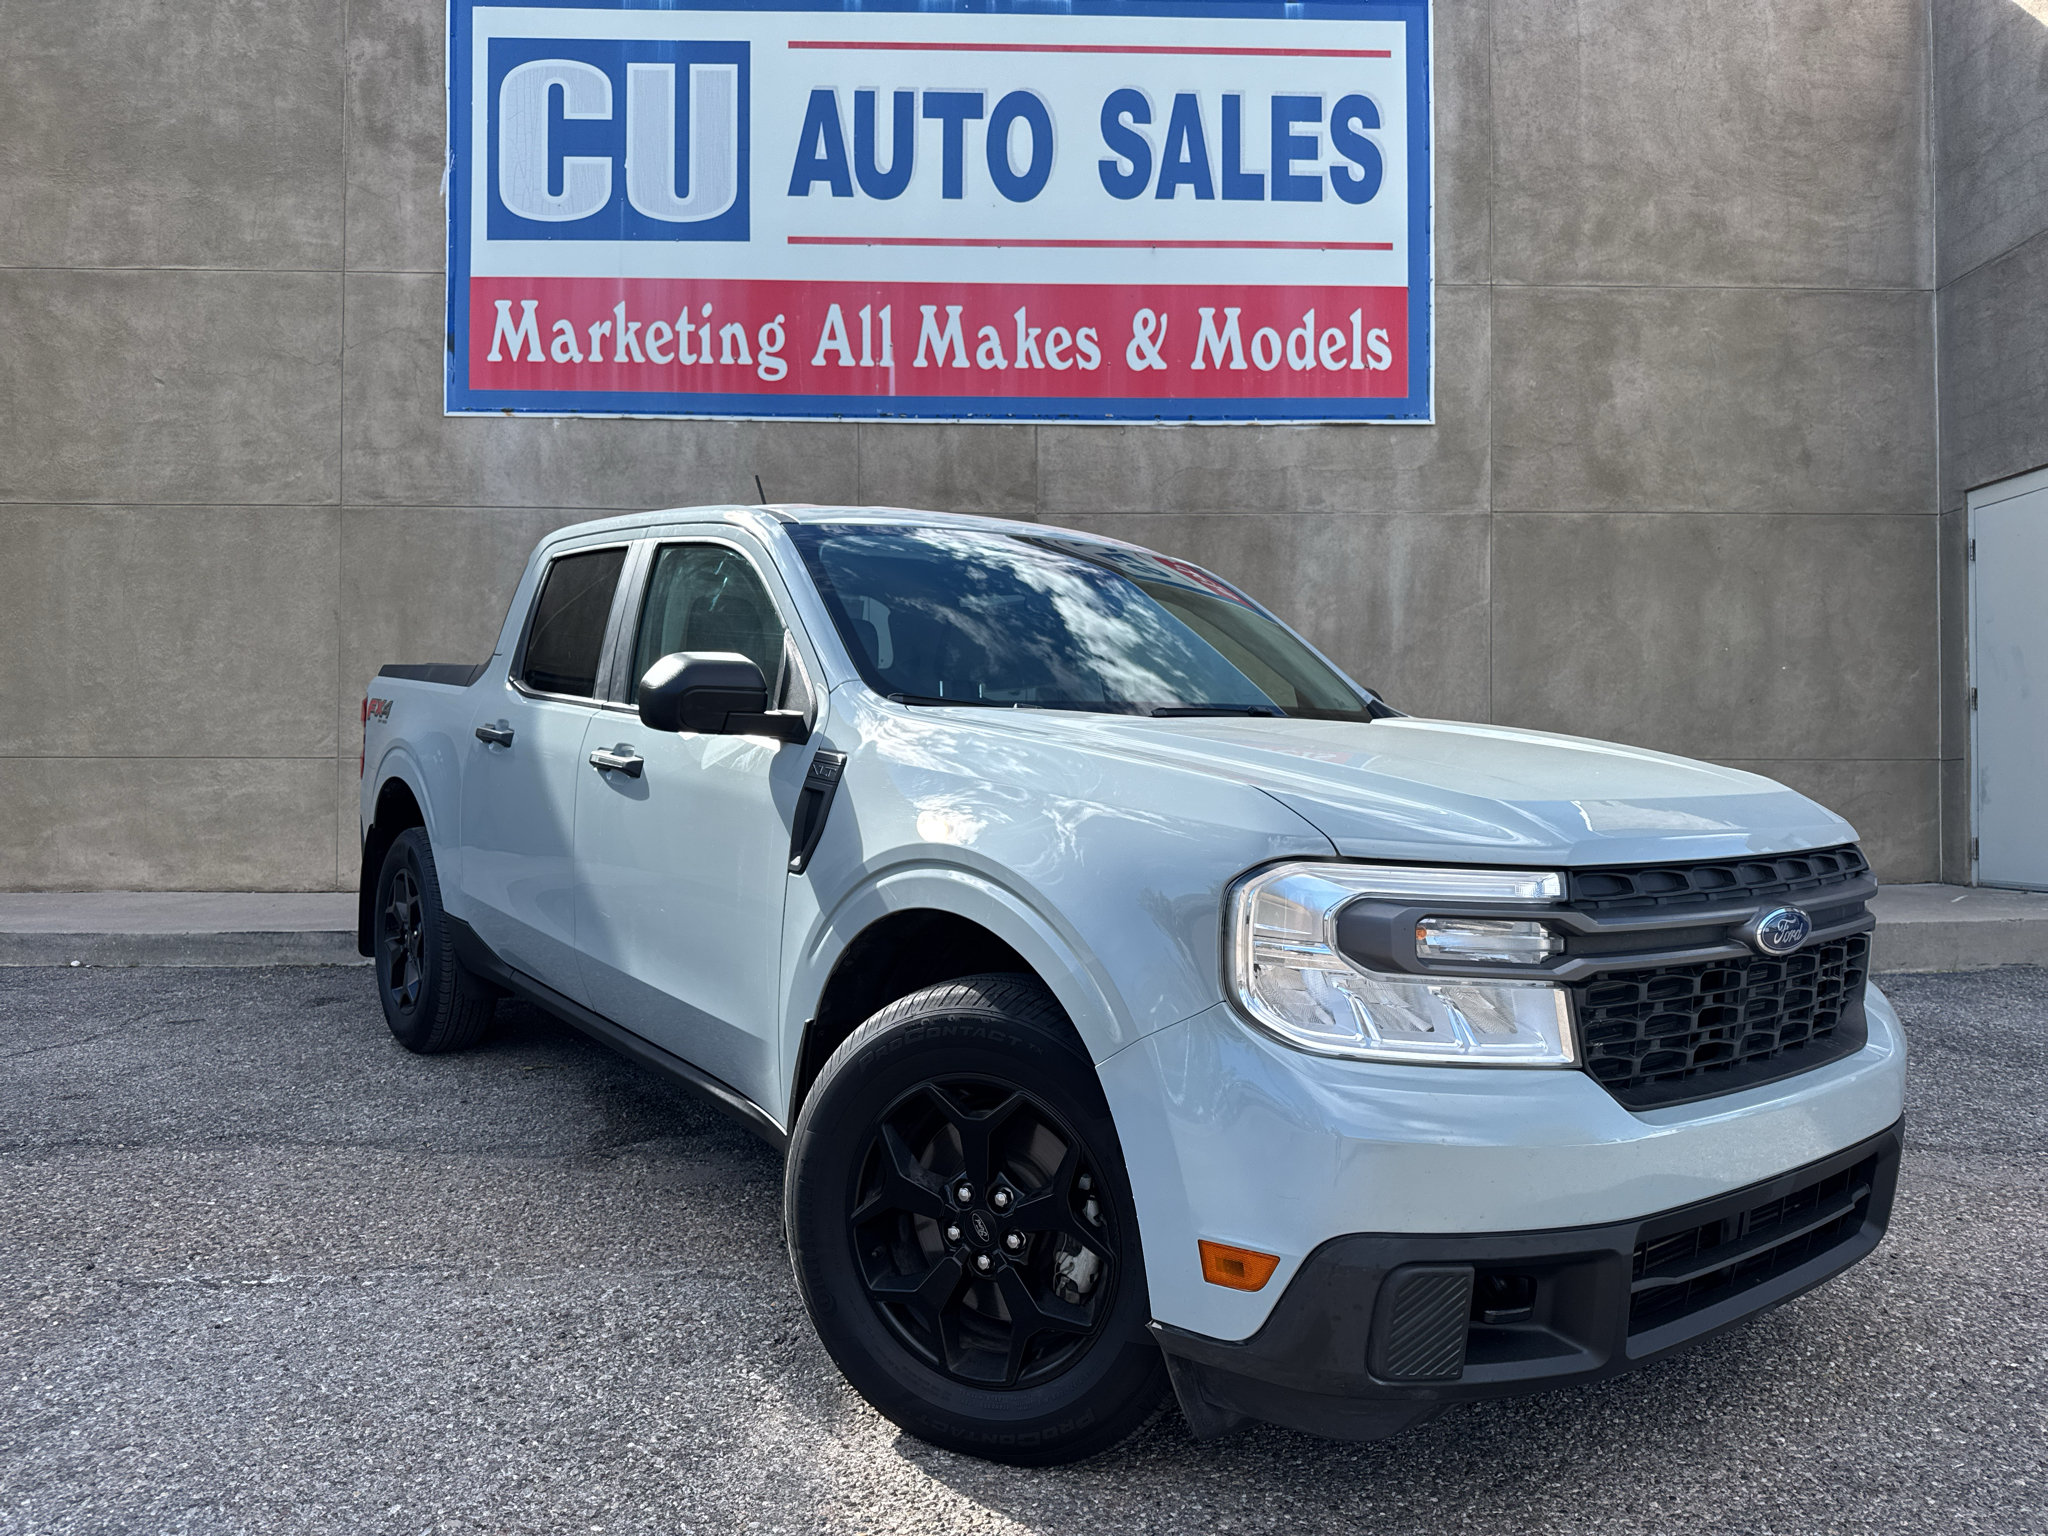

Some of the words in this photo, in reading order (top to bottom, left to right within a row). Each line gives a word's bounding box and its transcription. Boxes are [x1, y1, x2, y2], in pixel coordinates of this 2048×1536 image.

[499, 58, 739, 222] CU
[787, 86, 1057, 203] AUTO
[1098, 86, 1386, 205] SALES
[486, 299, 788, 382] Marketing
[811, 303, 895, 368] All
[912, 304, 1101, 371] Makes
[1125, 307, 1169, 372] &
[1190, 307, 1393, 372] Models
[367, 697, 394, 720] FX4
[811, 762, 838, 778] XLT
[1773, 916, 1803, 945] Ford
